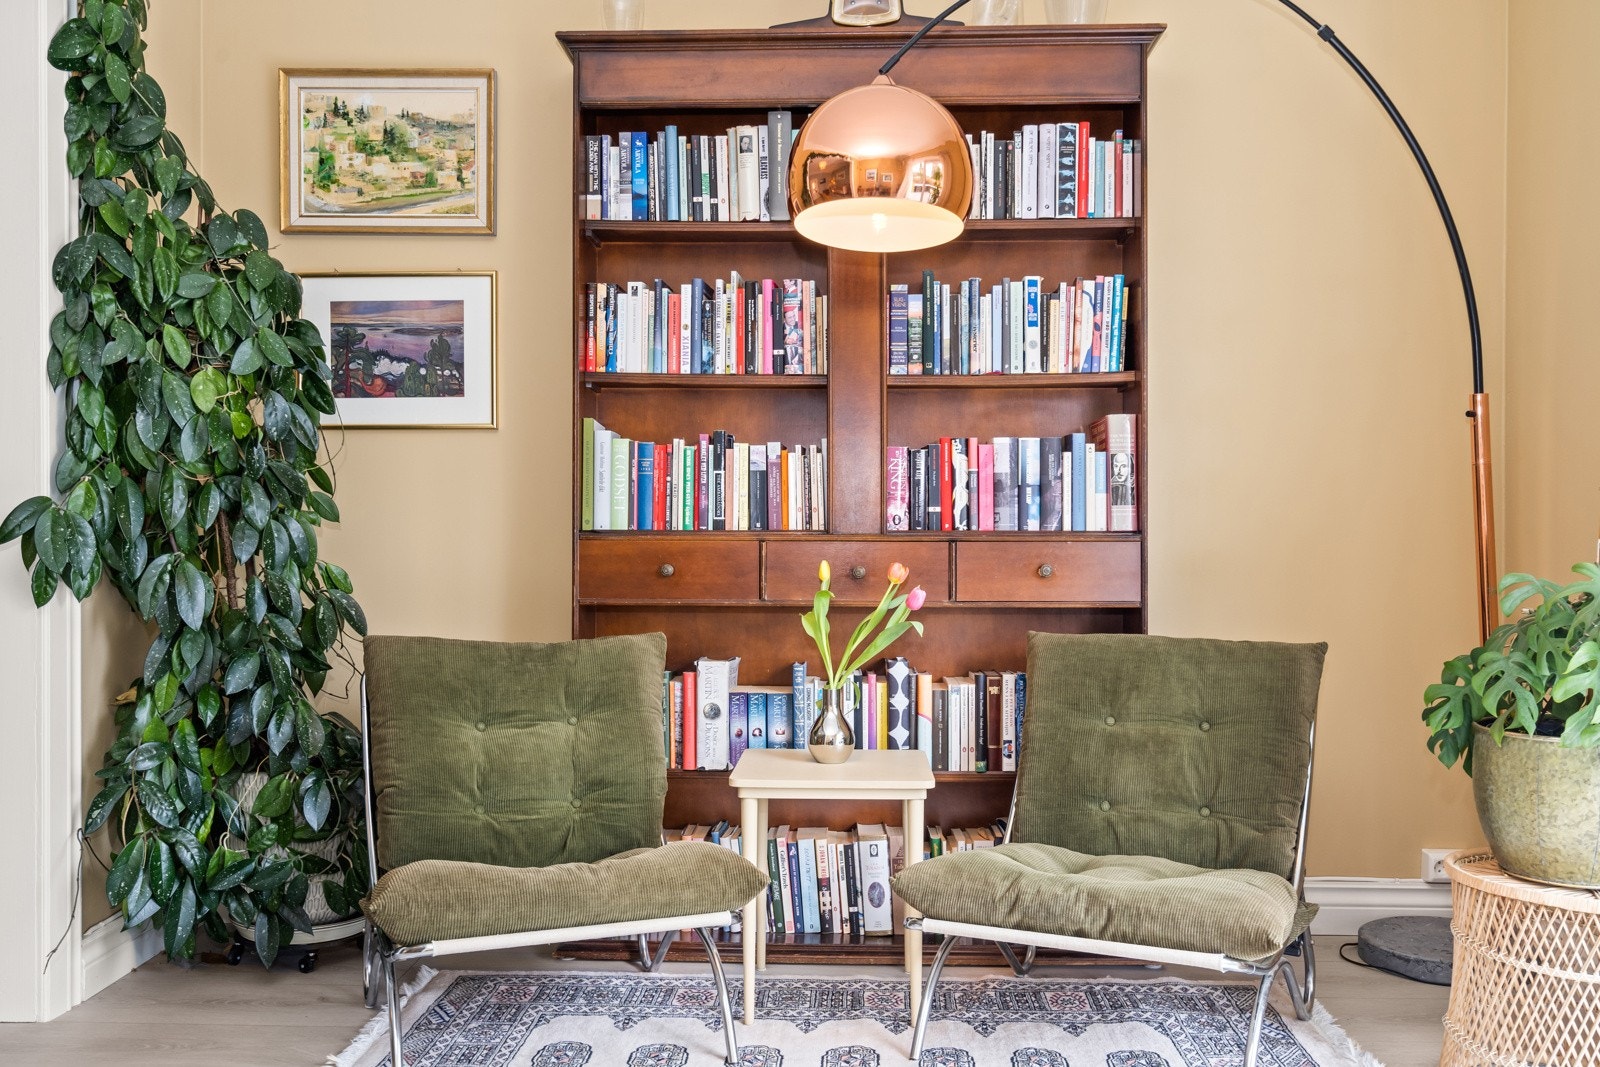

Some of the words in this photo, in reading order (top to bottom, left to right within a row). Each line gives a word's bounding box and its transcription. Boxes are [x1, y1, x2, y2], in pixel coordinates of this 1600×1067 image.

[682, 335, 690, 366] XIANIA
[614, 454, 626, 512] GODSET
[704, 666, 713, 700] MARTIN
[705, 722, 713, 758] DRAGONS
